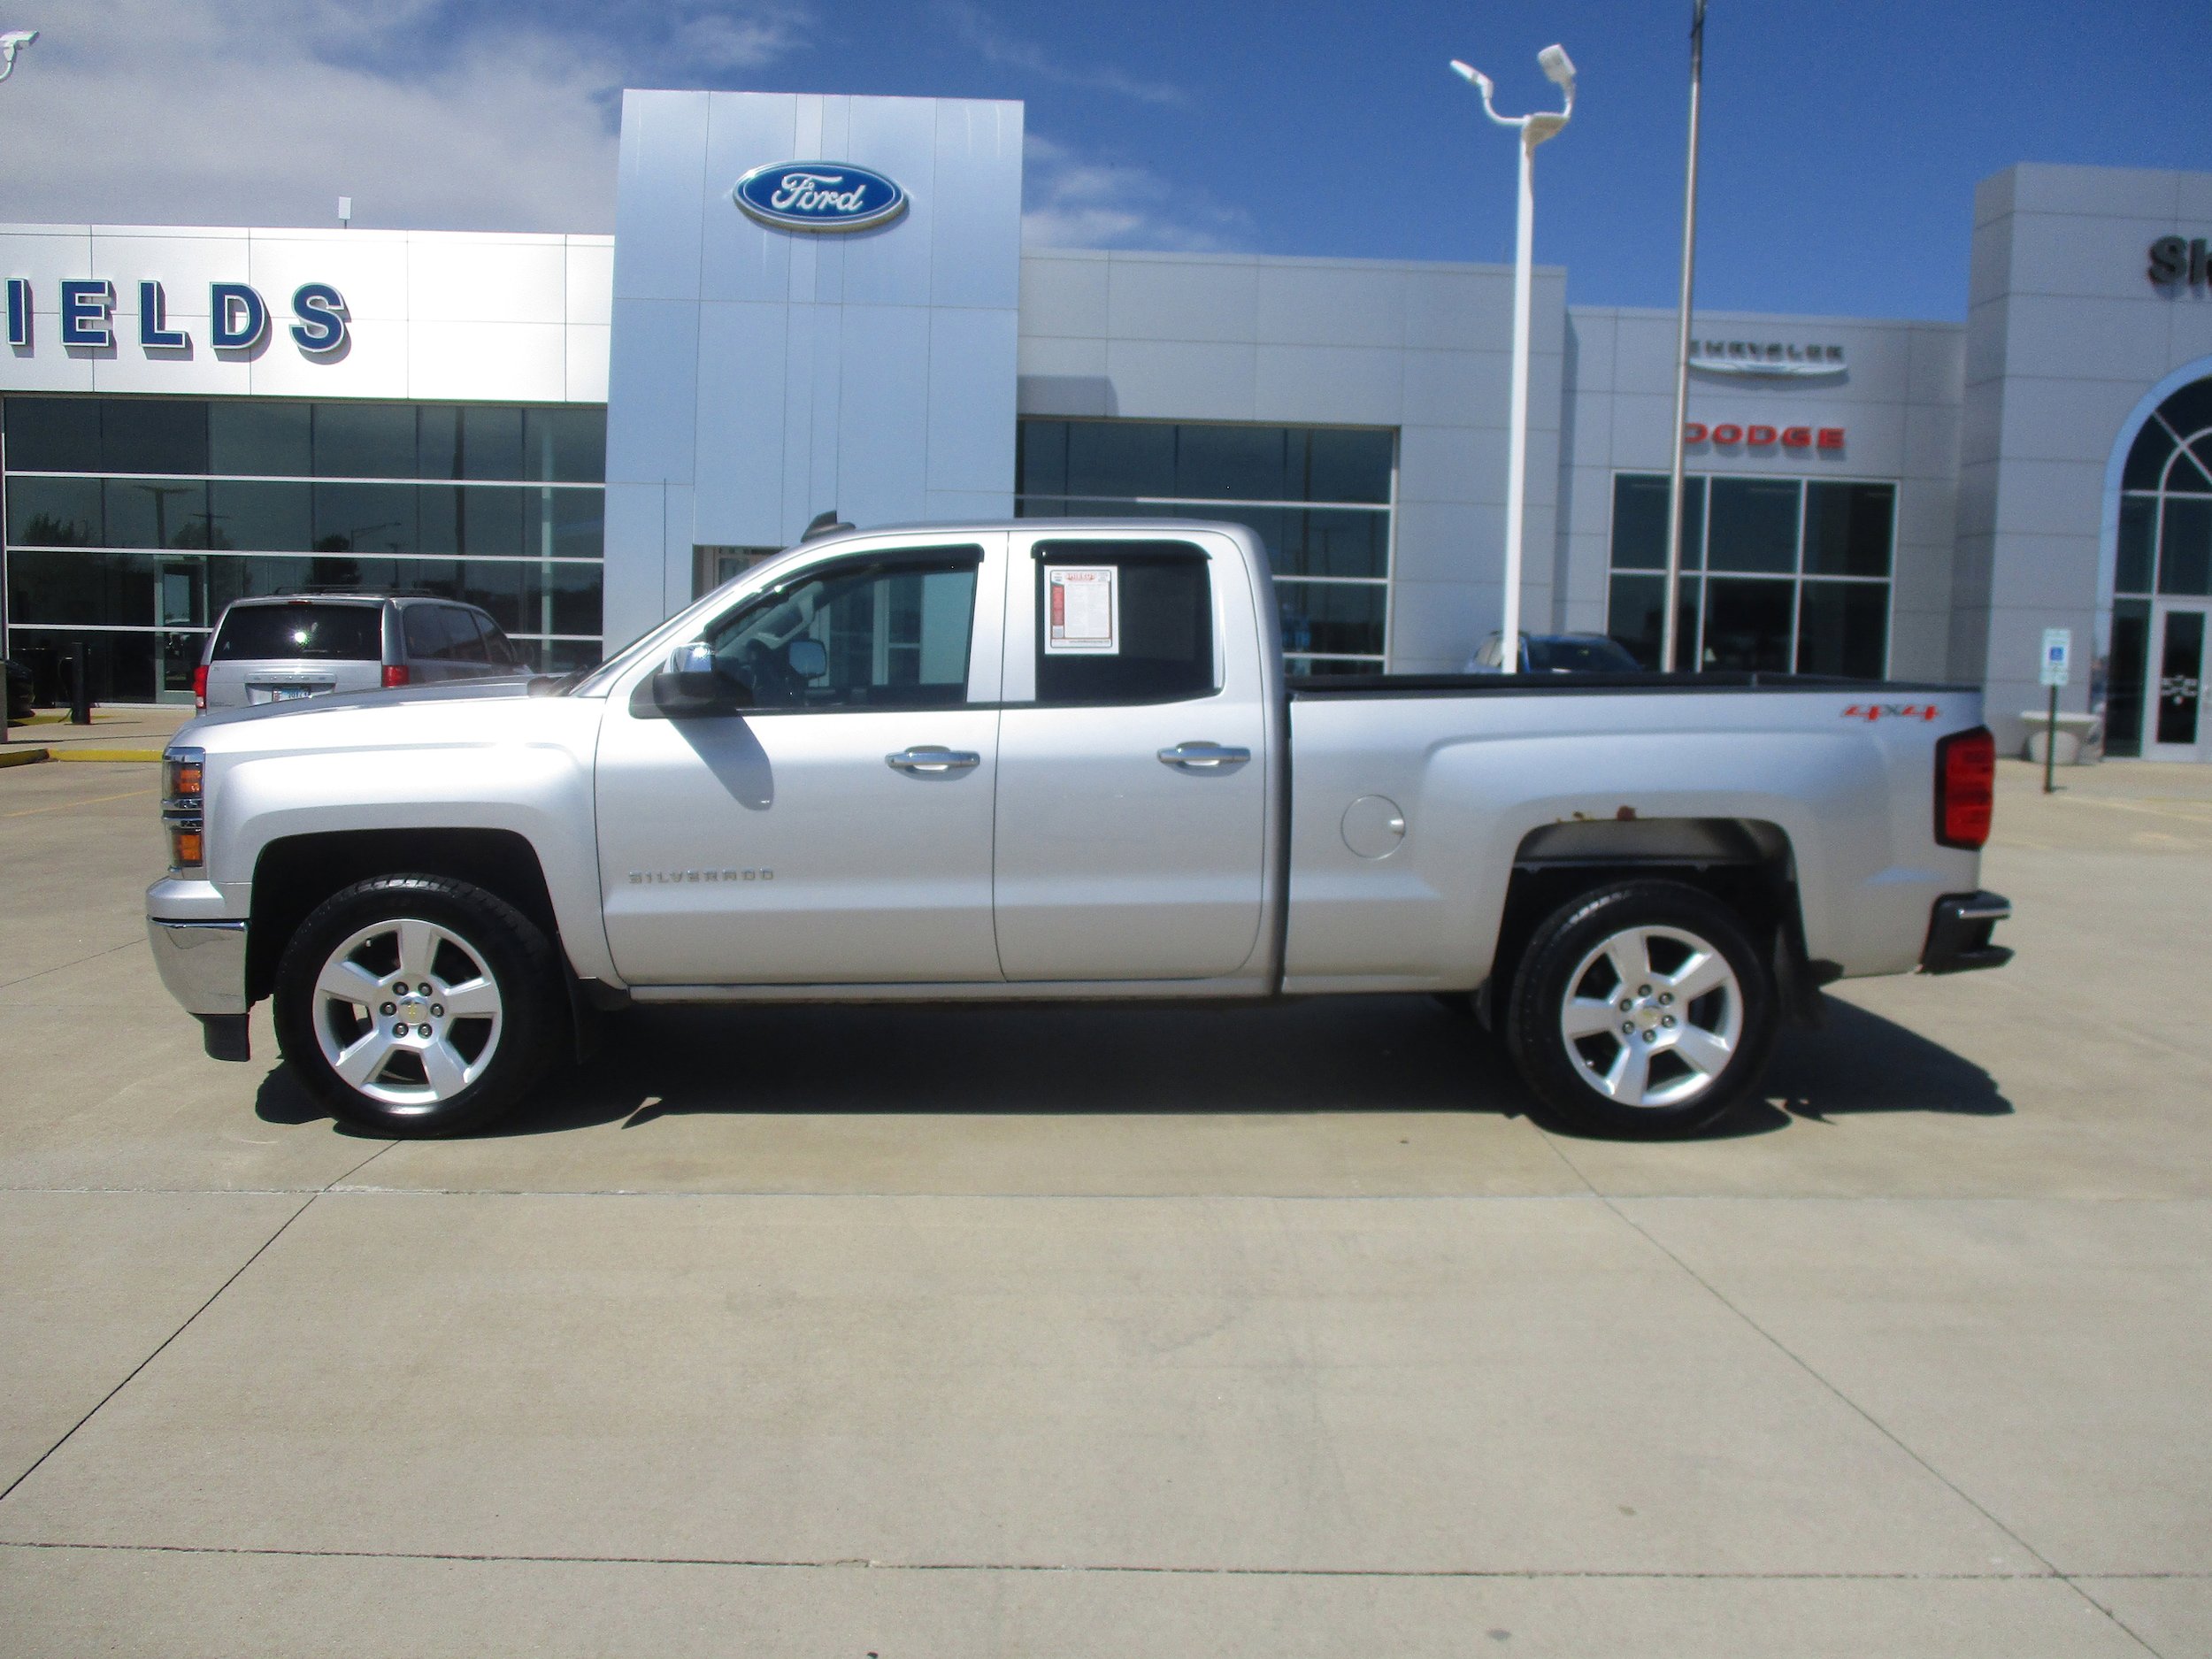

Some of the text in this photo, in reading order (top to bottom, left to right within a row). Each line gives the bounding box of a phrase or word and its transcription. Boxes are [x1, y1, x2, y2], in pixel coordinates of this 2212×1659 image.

[771, 173, 867, 211] Ford
[5, 277, 346, 353] IELDS
[1685, 422, 1846, 449] DODGE
[628, 867, 774, 884] SILVERADO
